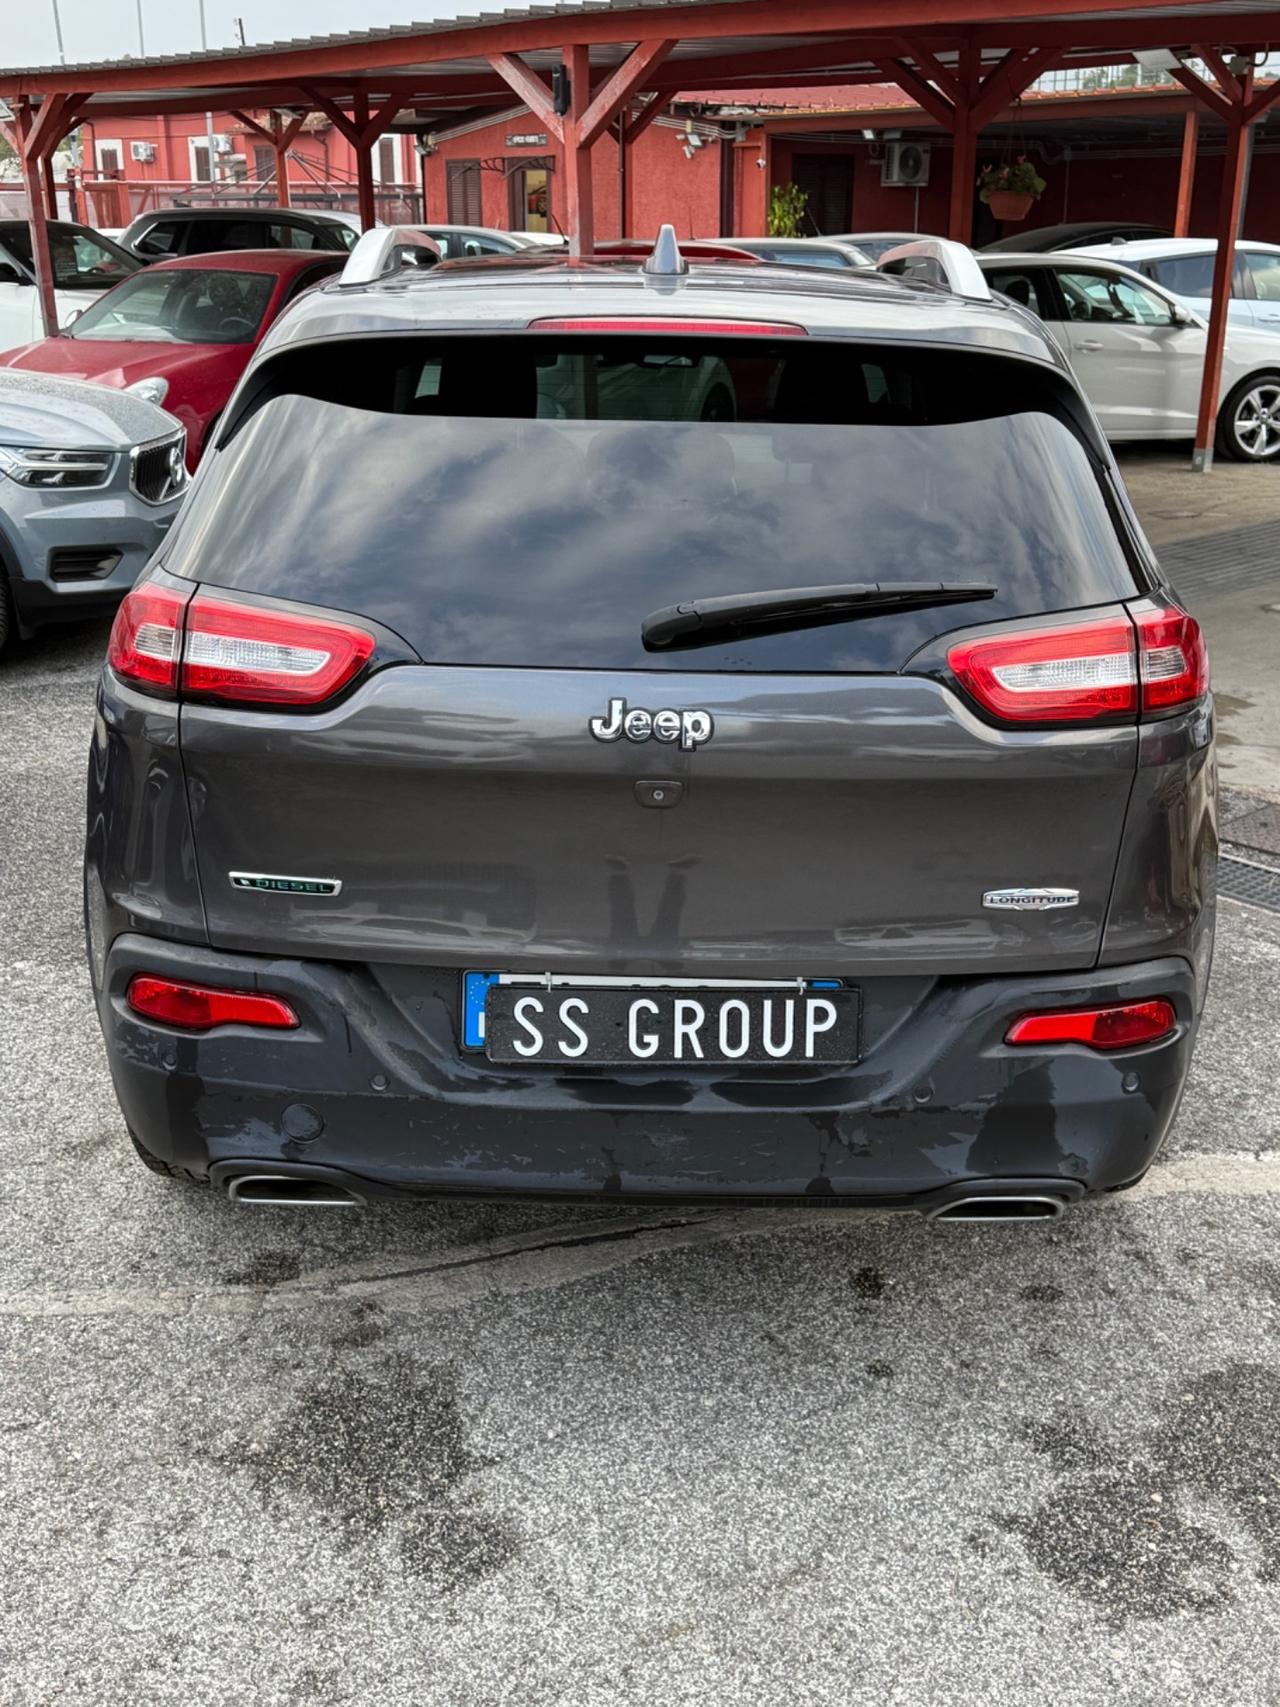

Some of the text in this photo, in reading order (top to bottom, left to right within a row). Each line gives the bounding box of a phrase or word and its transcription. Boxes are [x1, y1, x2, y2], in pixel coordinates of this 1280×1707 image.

[589, 697, 714, 751] Jeep
[256, 879, 331, 892] DIESEL
[990, 896, 1076, 904] LONGITUDE
[513, 997, 838, 1058] SS GROUP
